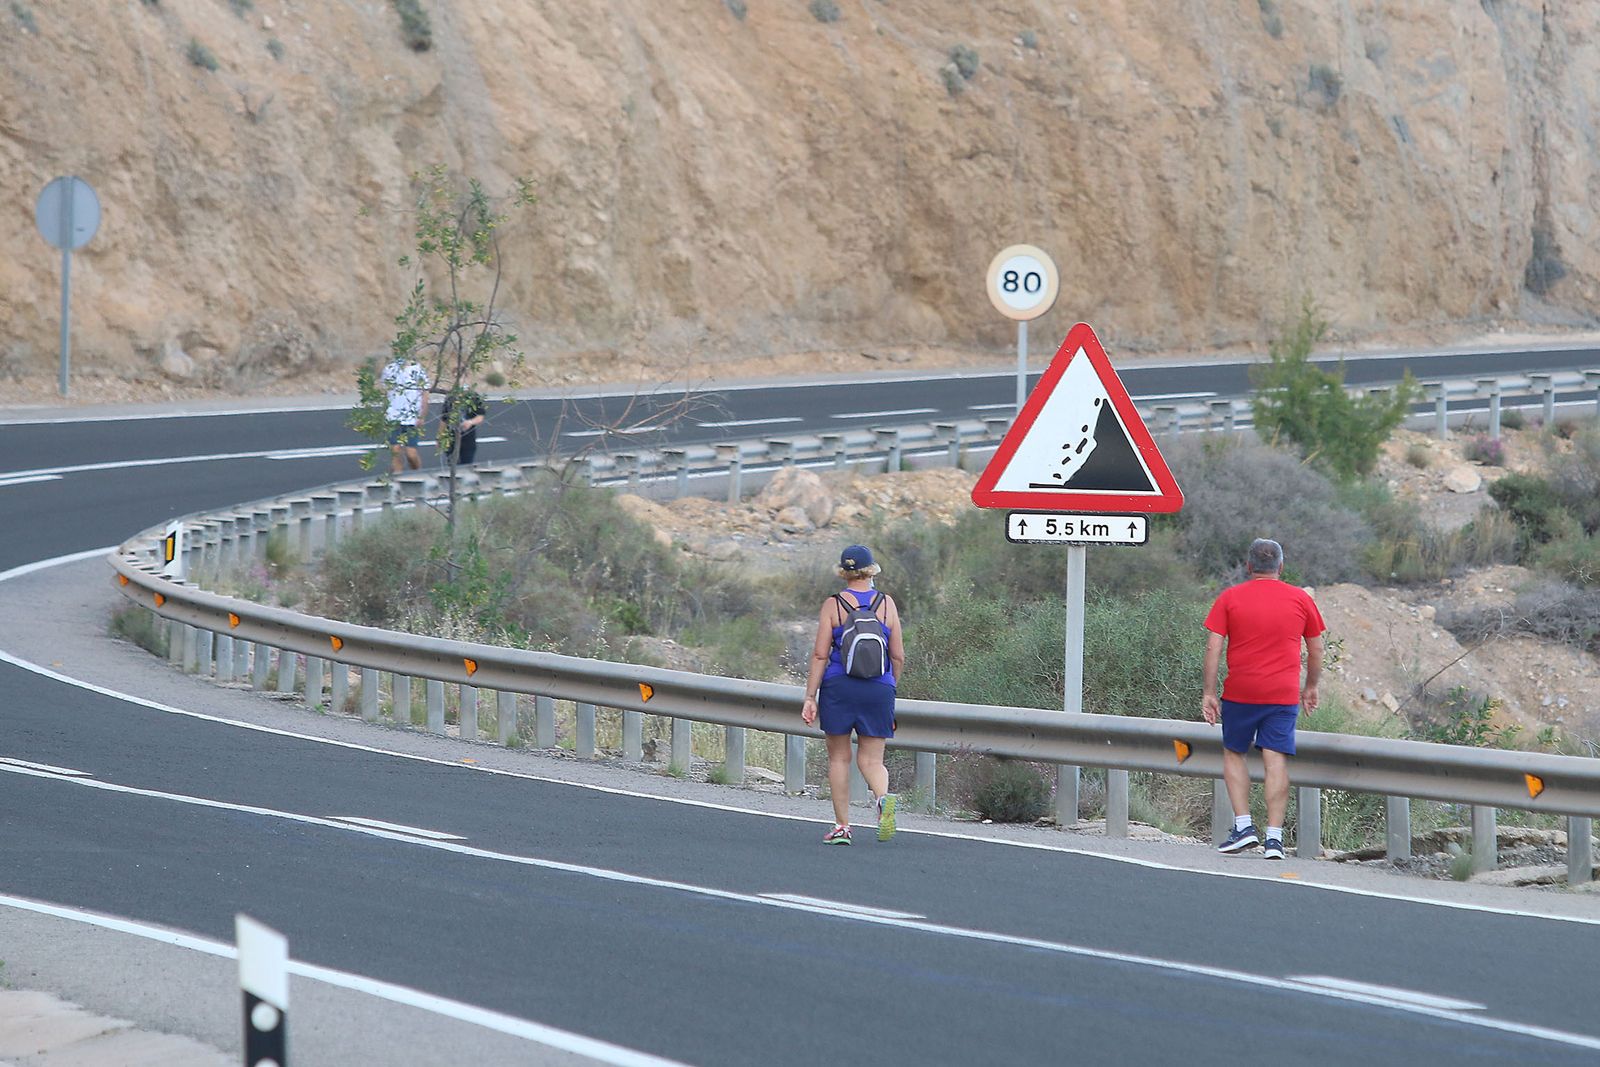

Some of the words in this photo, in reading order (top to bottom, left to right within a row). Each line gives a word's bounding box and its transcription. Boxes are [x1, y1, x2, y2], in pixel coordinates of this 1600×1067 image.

[1003, 270, 1041, 293] 80
[1046, 519, 1074, 536] 5.5
[1080, 519, 1109, 536] km
